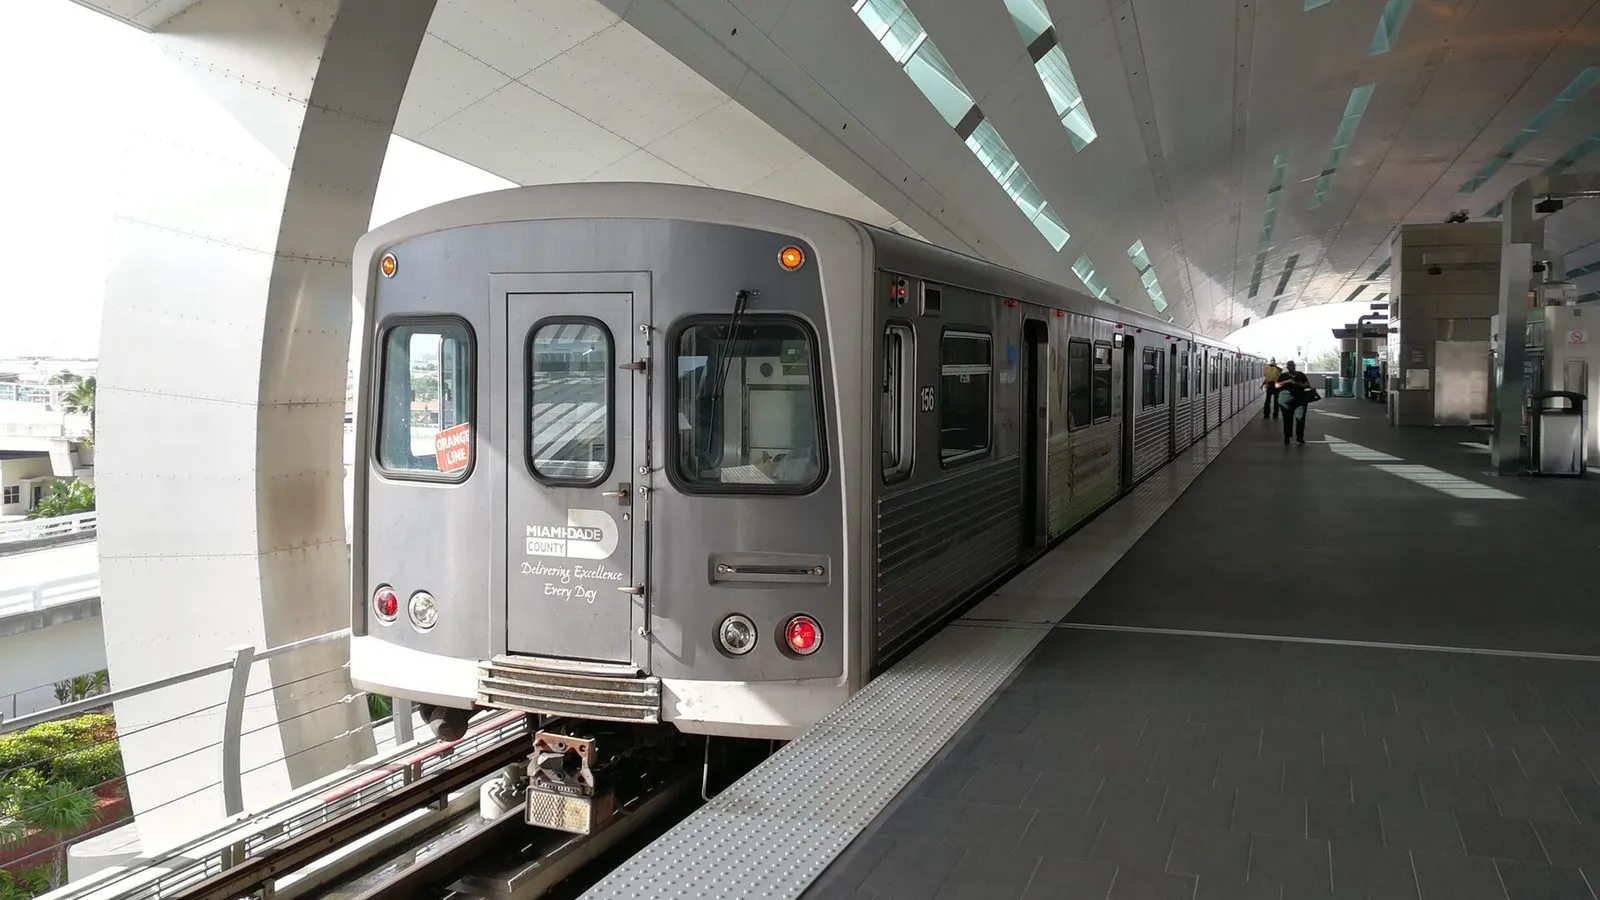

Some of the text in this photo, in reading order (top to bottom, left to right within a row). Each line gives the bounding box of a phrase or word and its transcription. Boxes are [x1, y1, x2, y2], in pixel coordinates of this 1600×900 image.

[921, 387, 934, 411] 156
[436, 429, 469, 451] ORANGE
[446, 447, 467, 465] LINE
[526, 525, 601, 541] MIAMI-DADE
[527, 541, 564, 553] COUNTY
[521, 560, 624, 584] Delivering Excellence
[544, 582, 597, 604] Every Day
